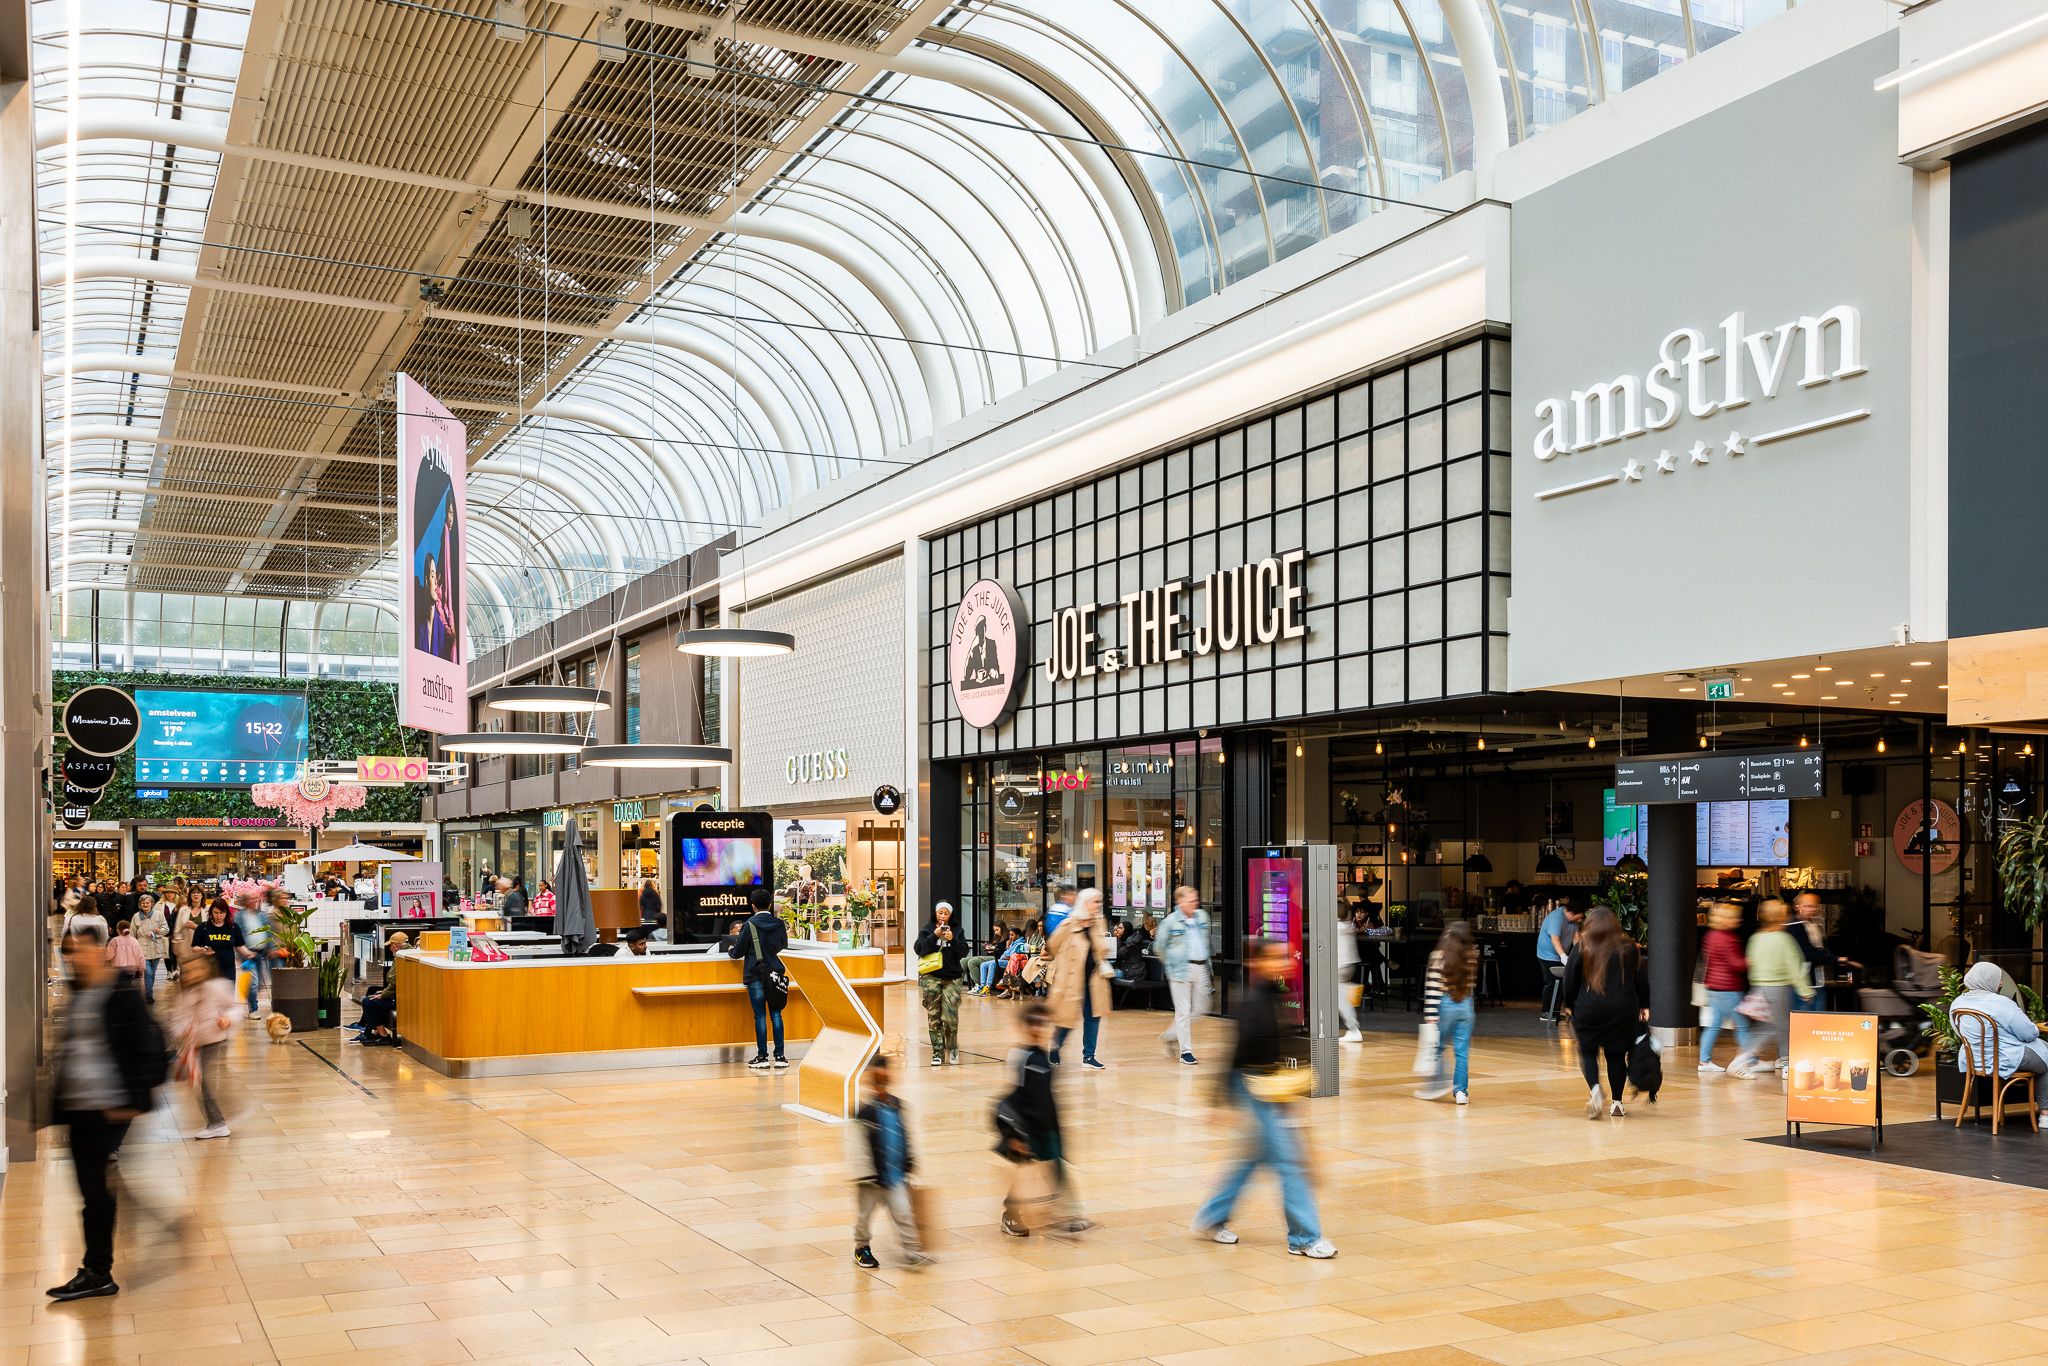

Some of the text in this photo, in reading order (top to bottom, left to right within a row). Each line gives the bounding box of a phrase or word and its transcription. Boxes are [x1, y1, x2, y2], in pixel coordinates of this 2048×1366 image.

[1534, 304, 1869, 461] amstlvn
[421, 434, 453, 477] stylish
[955, 590, 1011, 645] JOE & THE JUICE
[1045, 550, 1309, 683] JOE & THE JUICE
[422, 674, 453, 703] amstlvn
[71, 715, 132, 725] Massimo Dutti
[148, 709, 197, 718] amstelveen
[163, 725, 183, 737] 17°
[66, 763, 111, 771] ASPACT
[360, 762, 427, 780] YOYO!
[786, 748, 849, 785] GUESS
[65, 808, 87, 818] WE
[613, 801, 644, 822] DOUGLAS
[176, 818, 275, 827] DUNKIN' DONUTS
[700, 818, 745, 831] receptie
[1898, 813, 1911, 830] JOE
[68, 841, 112, 849] TIGER
[700, 893, 748, 906] amstlvn
